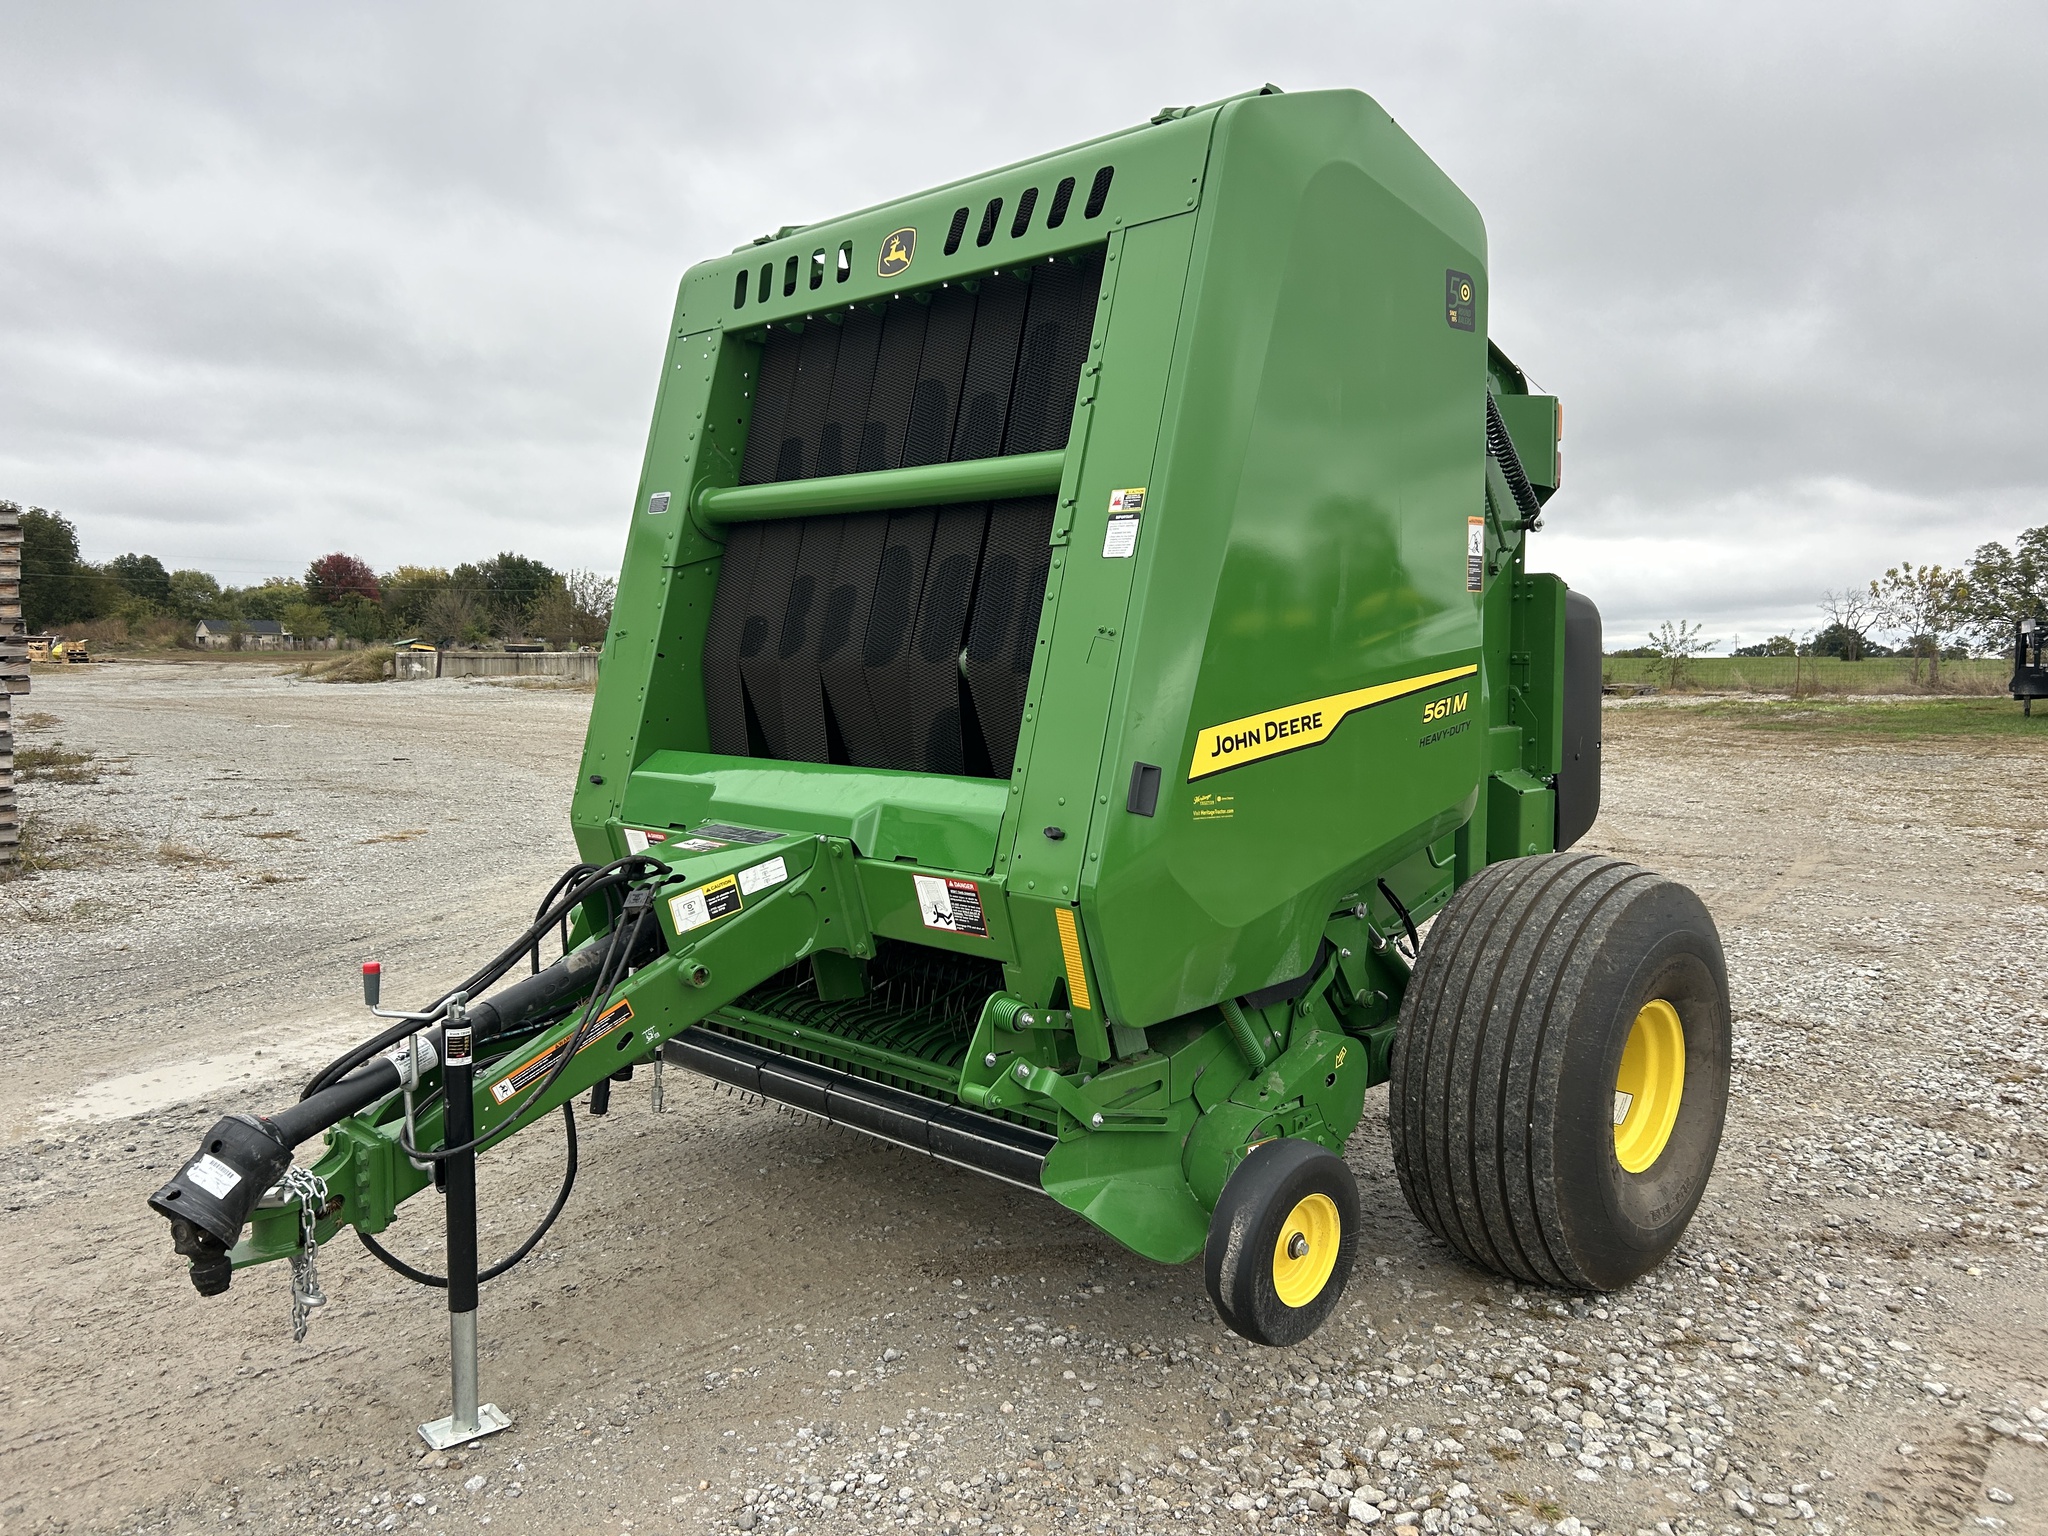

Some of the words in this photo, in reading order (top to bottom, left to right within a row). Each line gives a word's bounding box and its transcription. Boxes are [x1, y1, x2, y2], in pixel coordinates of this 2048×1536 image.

[1211, 729, 1260, 757] JOHN
[1265, 712, 1322, 742] DEERE
[1419, 720, 1471, 748] HEAVY-DUTY
[710, 879, 732, 890] CAUTION
